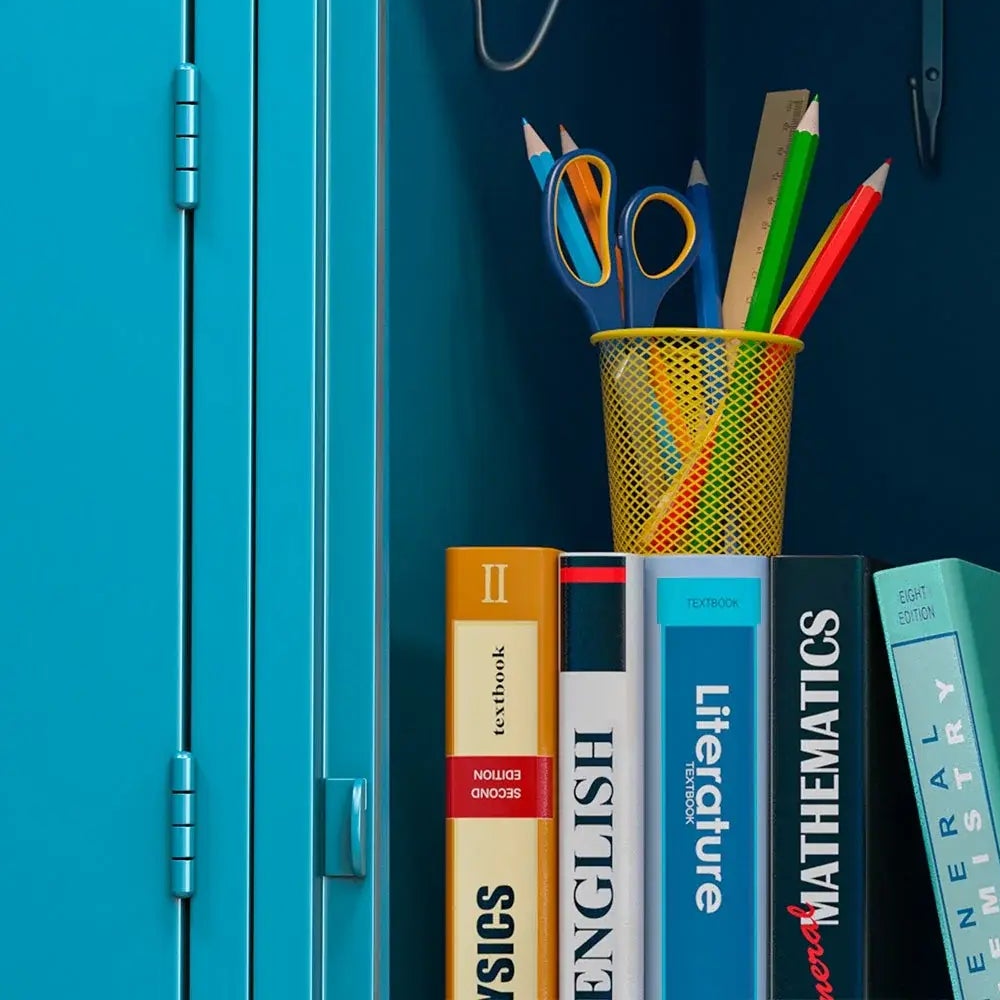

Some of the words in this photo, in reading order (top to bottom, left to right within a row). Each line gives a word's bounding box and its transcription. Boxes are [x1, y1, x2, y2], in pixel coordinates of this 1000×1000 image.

[687, 597, 740, 609] TEXTBOOK
[897, 604, 936, 625] EDITION
[898, 585, 927, 605] EIGHT
[491, 645, 506, 736] textbook
[471, 788, 522, 799] SECOND
[473, 769, 522, 781] EDITION
[684, 761, 695, 825] TEXTBOOK
[799, 608, 840, 926] MATHEMATICS
[695, 684, 730, 915] Literature
[573, 727, 614, 1000] ENGLISH
[920, 724, 990, 1000] ENERAL
